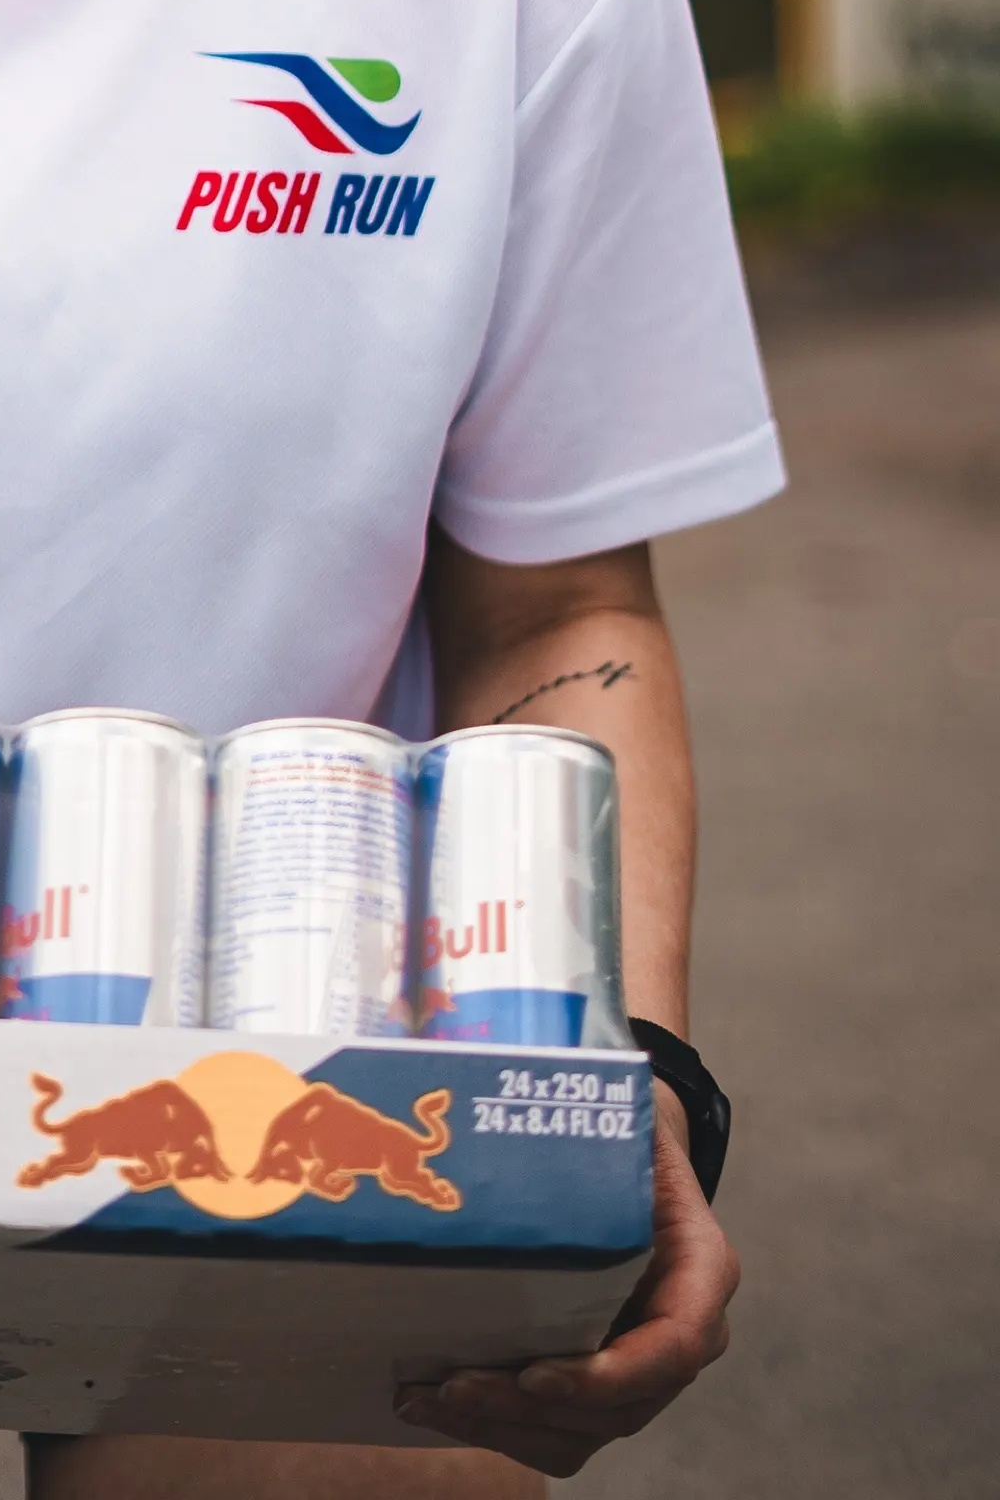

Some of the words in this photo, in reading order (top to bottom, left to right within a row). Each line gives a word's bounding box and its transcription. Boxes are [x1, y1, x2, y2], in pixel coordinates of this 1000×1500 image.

[175, 169, 323, 235] PUSH
[323, 172, 437, 237] RUN
[604, 1073, 635, 1103] ml
